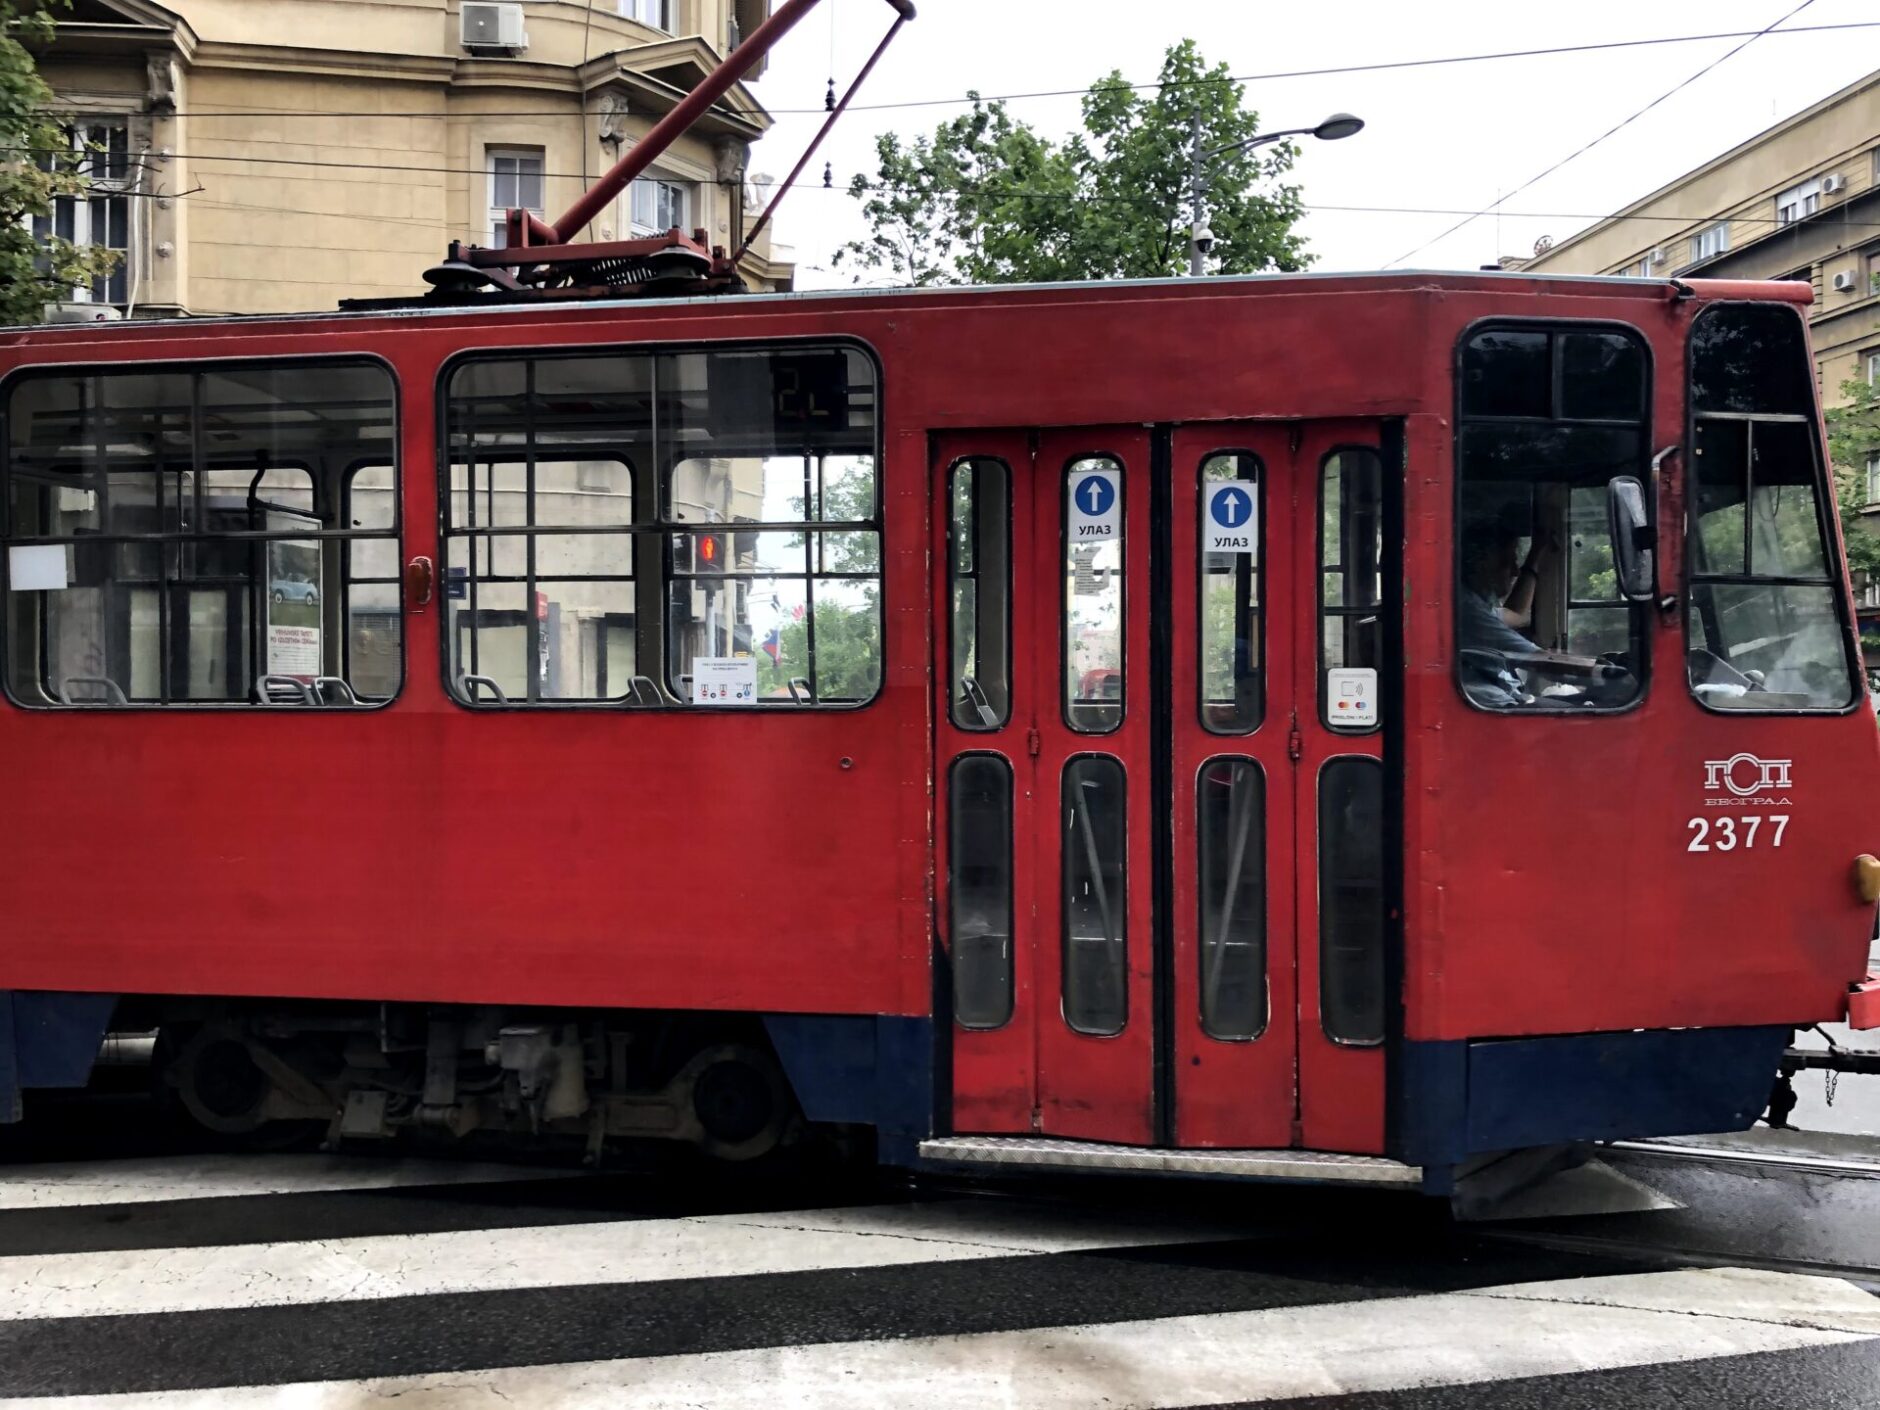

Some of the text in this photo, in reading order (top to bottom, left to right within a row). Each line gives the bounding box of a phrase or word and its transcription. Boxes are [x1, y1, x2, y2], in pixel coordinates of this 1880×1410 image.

[1079, 525, 1112, 537] УЛАЗ
[1214, 537, 1249, 548] УЛАЗ
[1704, 752, 1793, 796] ГСП
[1704, 797, 1793, 806] БЕОГРАД
[1687, 815, 1790, 852] 2377
